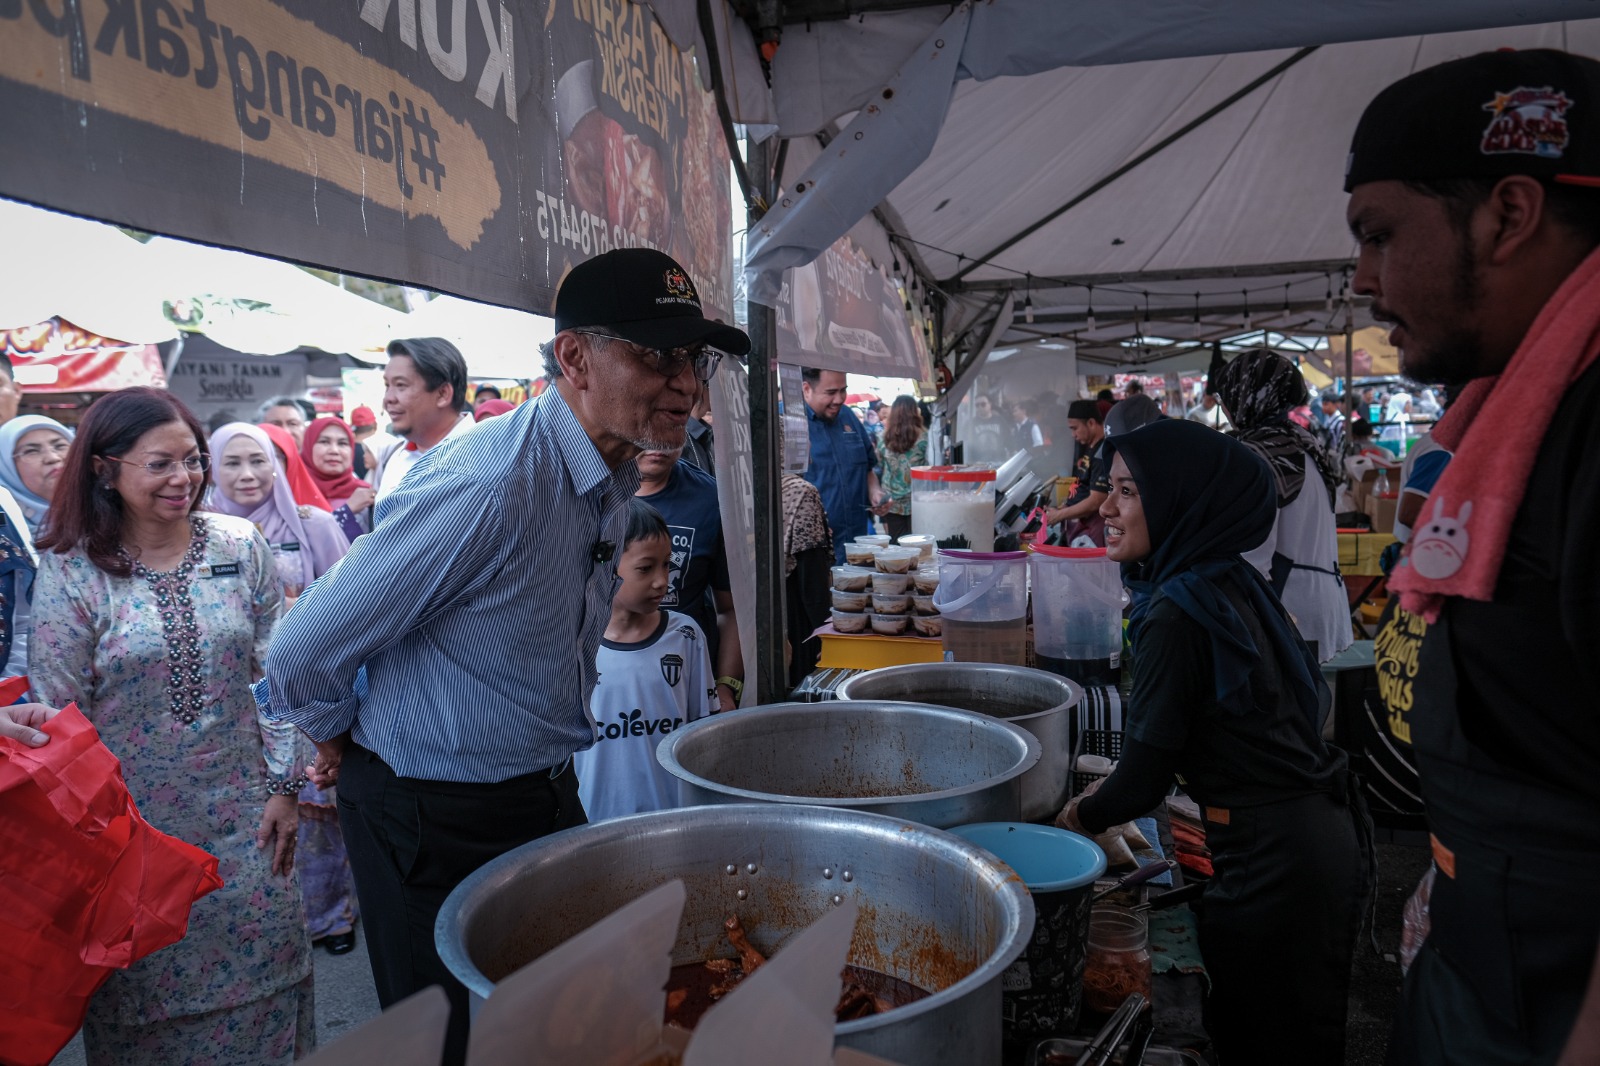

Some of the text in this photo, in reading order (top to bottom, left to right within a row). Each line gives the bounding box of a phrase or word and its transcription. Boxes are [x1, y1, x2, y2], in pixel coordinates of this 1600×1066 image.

[230, 362, 283, 378] TANAM
[672, 534, 691, 548] CO.
[214, 565, 237, 575] SURIANI
